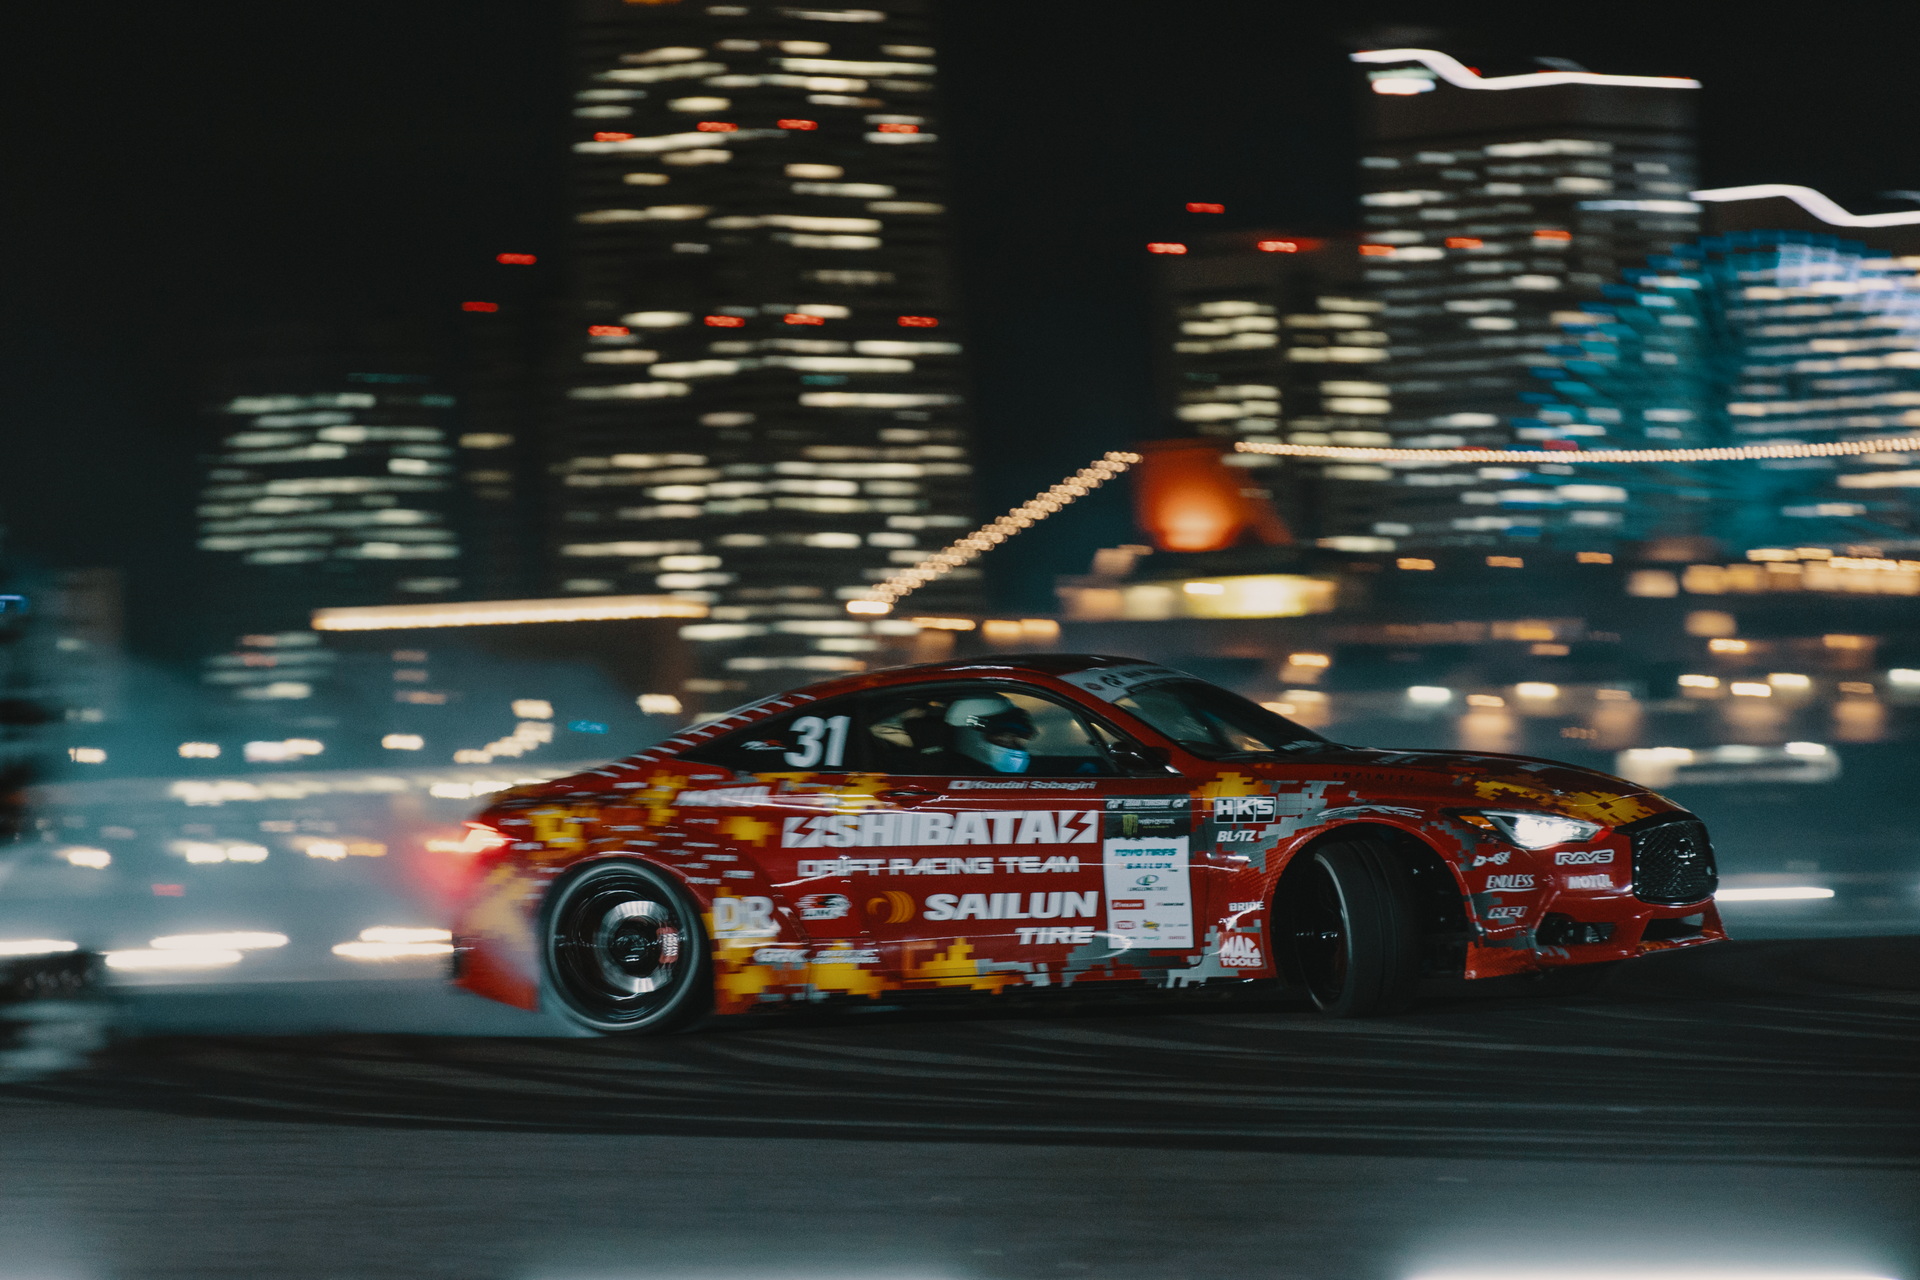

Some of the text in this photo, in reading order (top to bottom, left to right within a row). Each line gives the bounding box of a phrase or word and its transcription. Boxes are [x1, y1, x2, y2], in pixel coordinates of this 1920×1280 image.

[783, 715, 851, 768] 31
[1216, 798, 1275, 815] HKS
[824, 812, 1058, 848] SHIBATA
[797, 856, 1080, 877] DRIFT RACING TEAM
[1555, 849, 1615, 865] RAYS
[1485, 874, 1535, 889] ENDLESS
[1567, 874, 1614, 889] MOTUL
[923, 890, 1099, 921] SAILUN
[1015, 926, 1095, 945] TIRE
[1220, 935, 1261, 958] MAC
[1220, 958, 1262, 967] TOOLS
